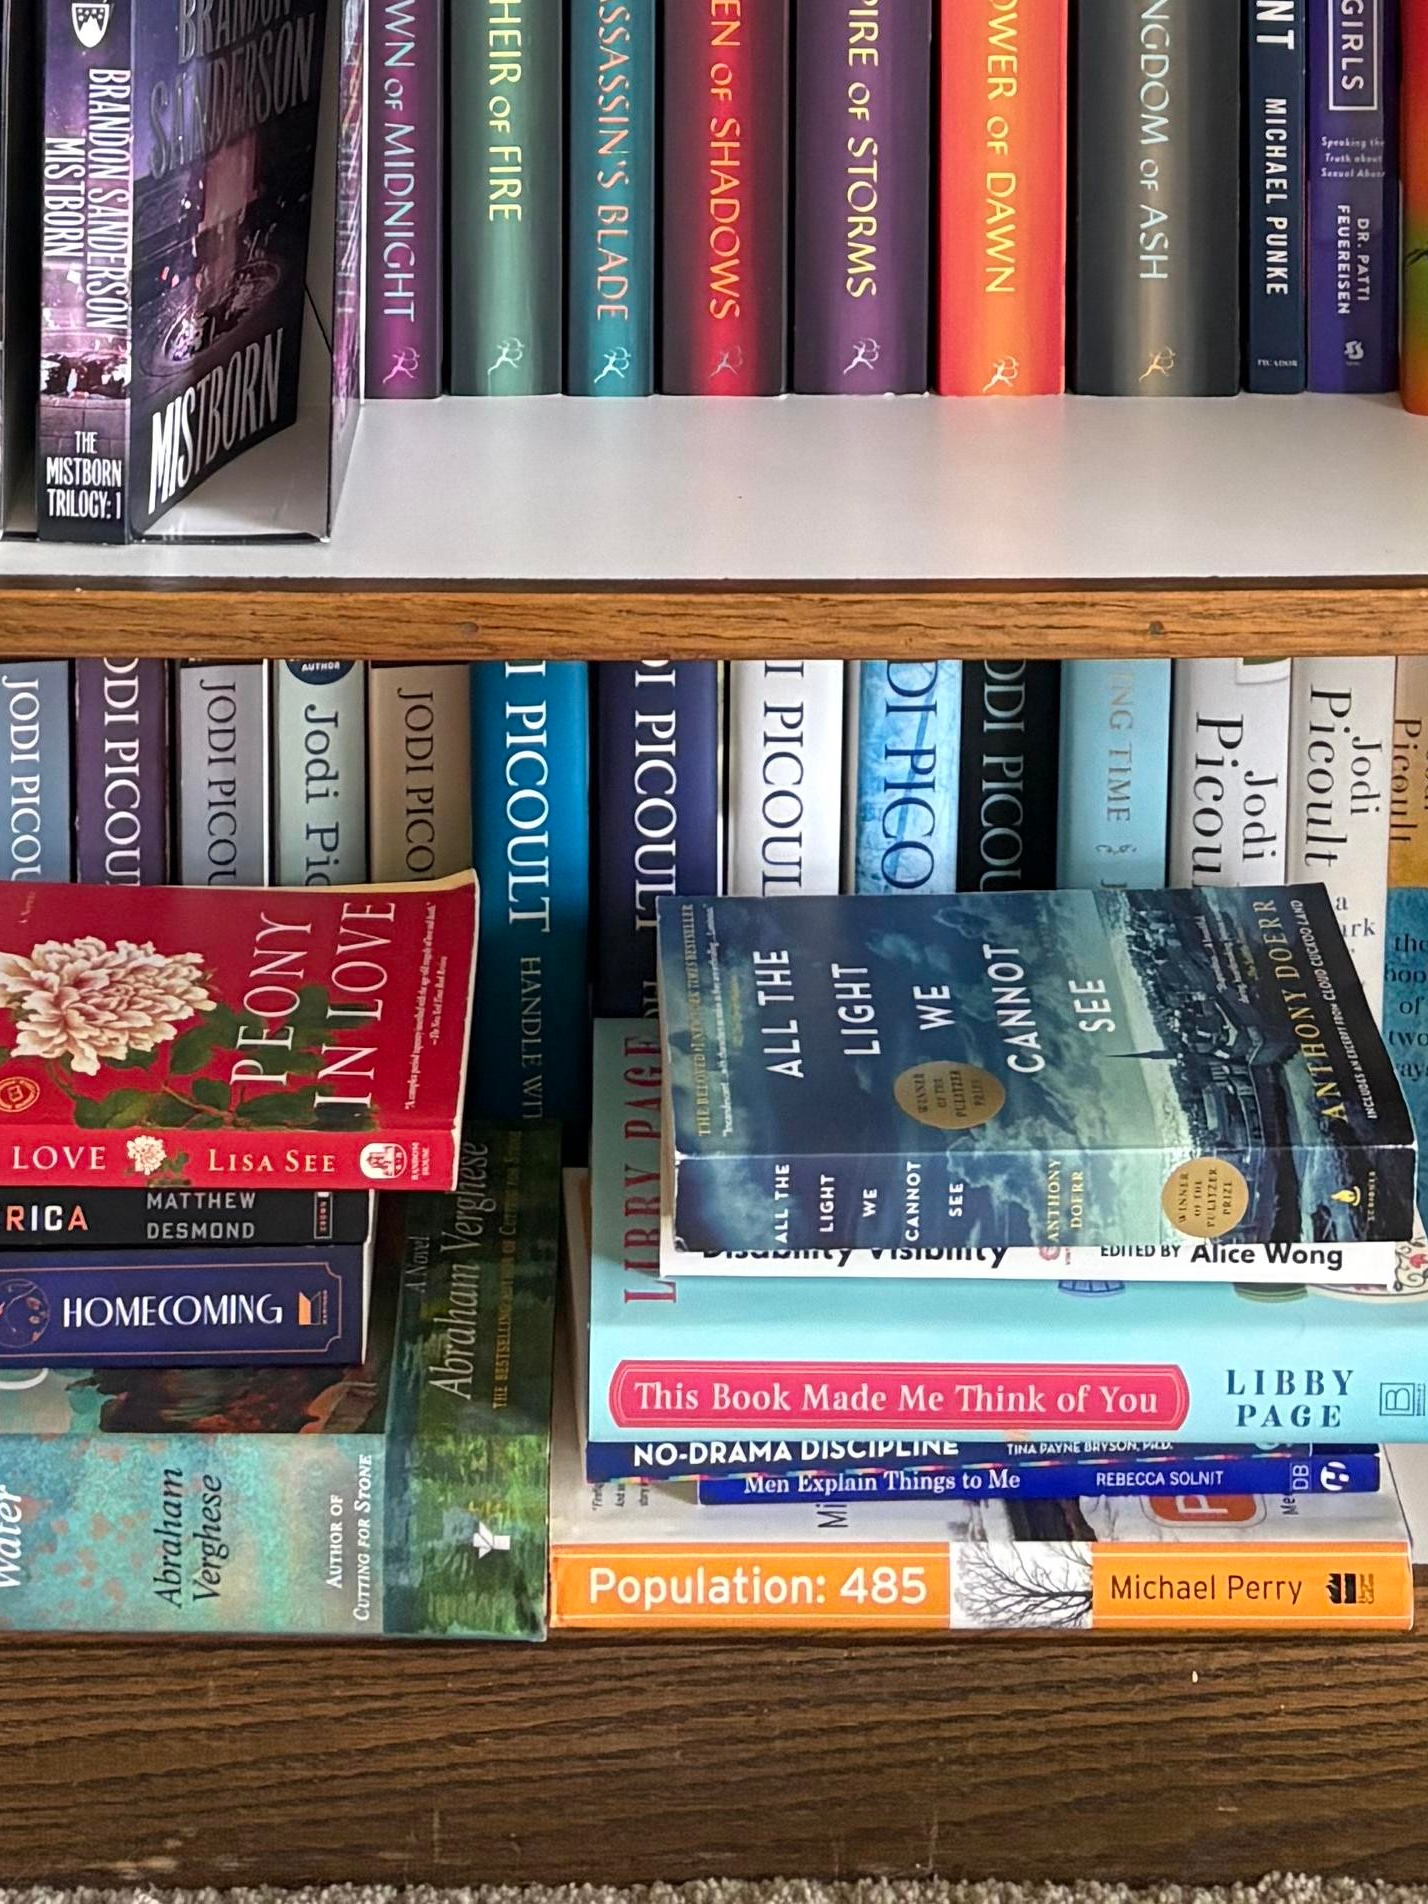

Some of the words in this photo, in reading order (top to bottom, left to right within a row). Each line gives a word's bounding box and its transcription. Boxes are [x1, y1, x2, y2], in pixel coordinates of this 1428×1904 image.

[11, 1143, 107, 1172] LOVE
[61, 1295, 284, 1328] HOMECOMING
[1224, 1368, 1354, 1397] LIBBY
[634, 1382, 702, 1412] This
[712, 1382, 792, 1412] Book
[802, 1383, 889, 1413] Made
[899, 1384, 945, 1413] Me
[955, 1385, 1048, 1414] Think
[1056, 1385, 1090, 1414] of
[1098, 1386, 1159, 1415] You
[1236, 1403, 1342, 1429] PAGE
[588, 1568, 827, 1608] Population:
[839, 1564, 927, 1604] 485
